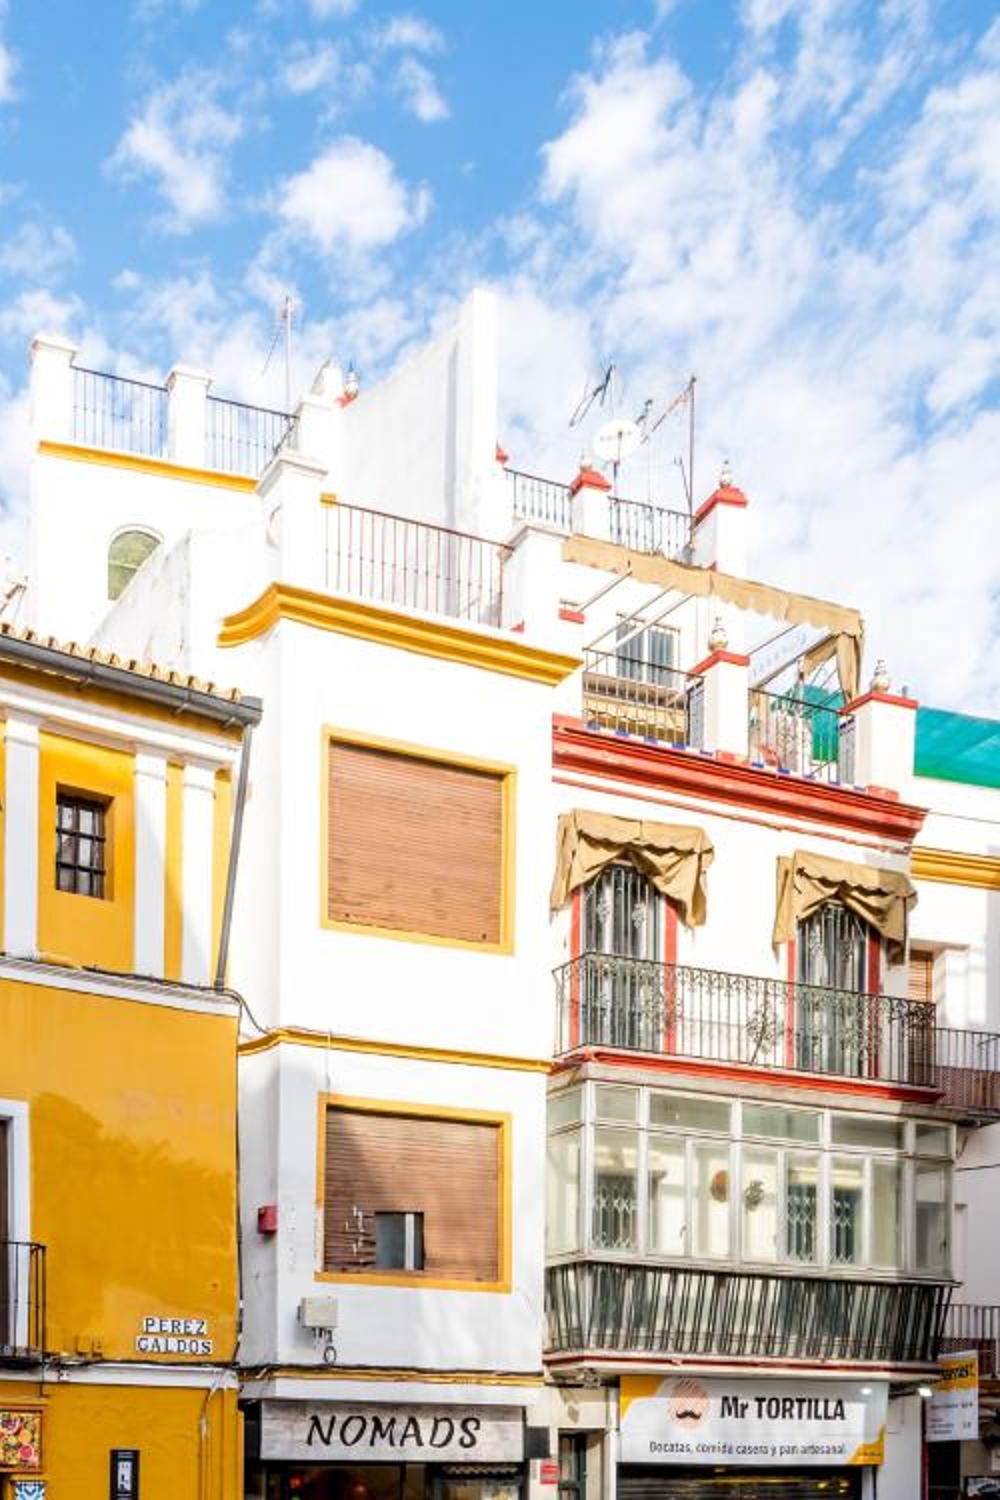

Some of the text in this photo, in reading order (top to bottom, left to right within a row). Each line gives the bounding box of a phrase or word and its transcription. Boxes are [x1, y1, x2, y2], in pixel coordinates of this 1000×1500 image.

[144, 1317, 205, 1336] PEREZ
[138, 1337, 211, 1355] GALDOS
[720, 1396, 846, 1421] Mr TORTILLA
[306, 1415, 481, 1448] NOMADS
[695, 1441, 733, 1455] comida
[779, 1445, 799, 1457] pan
